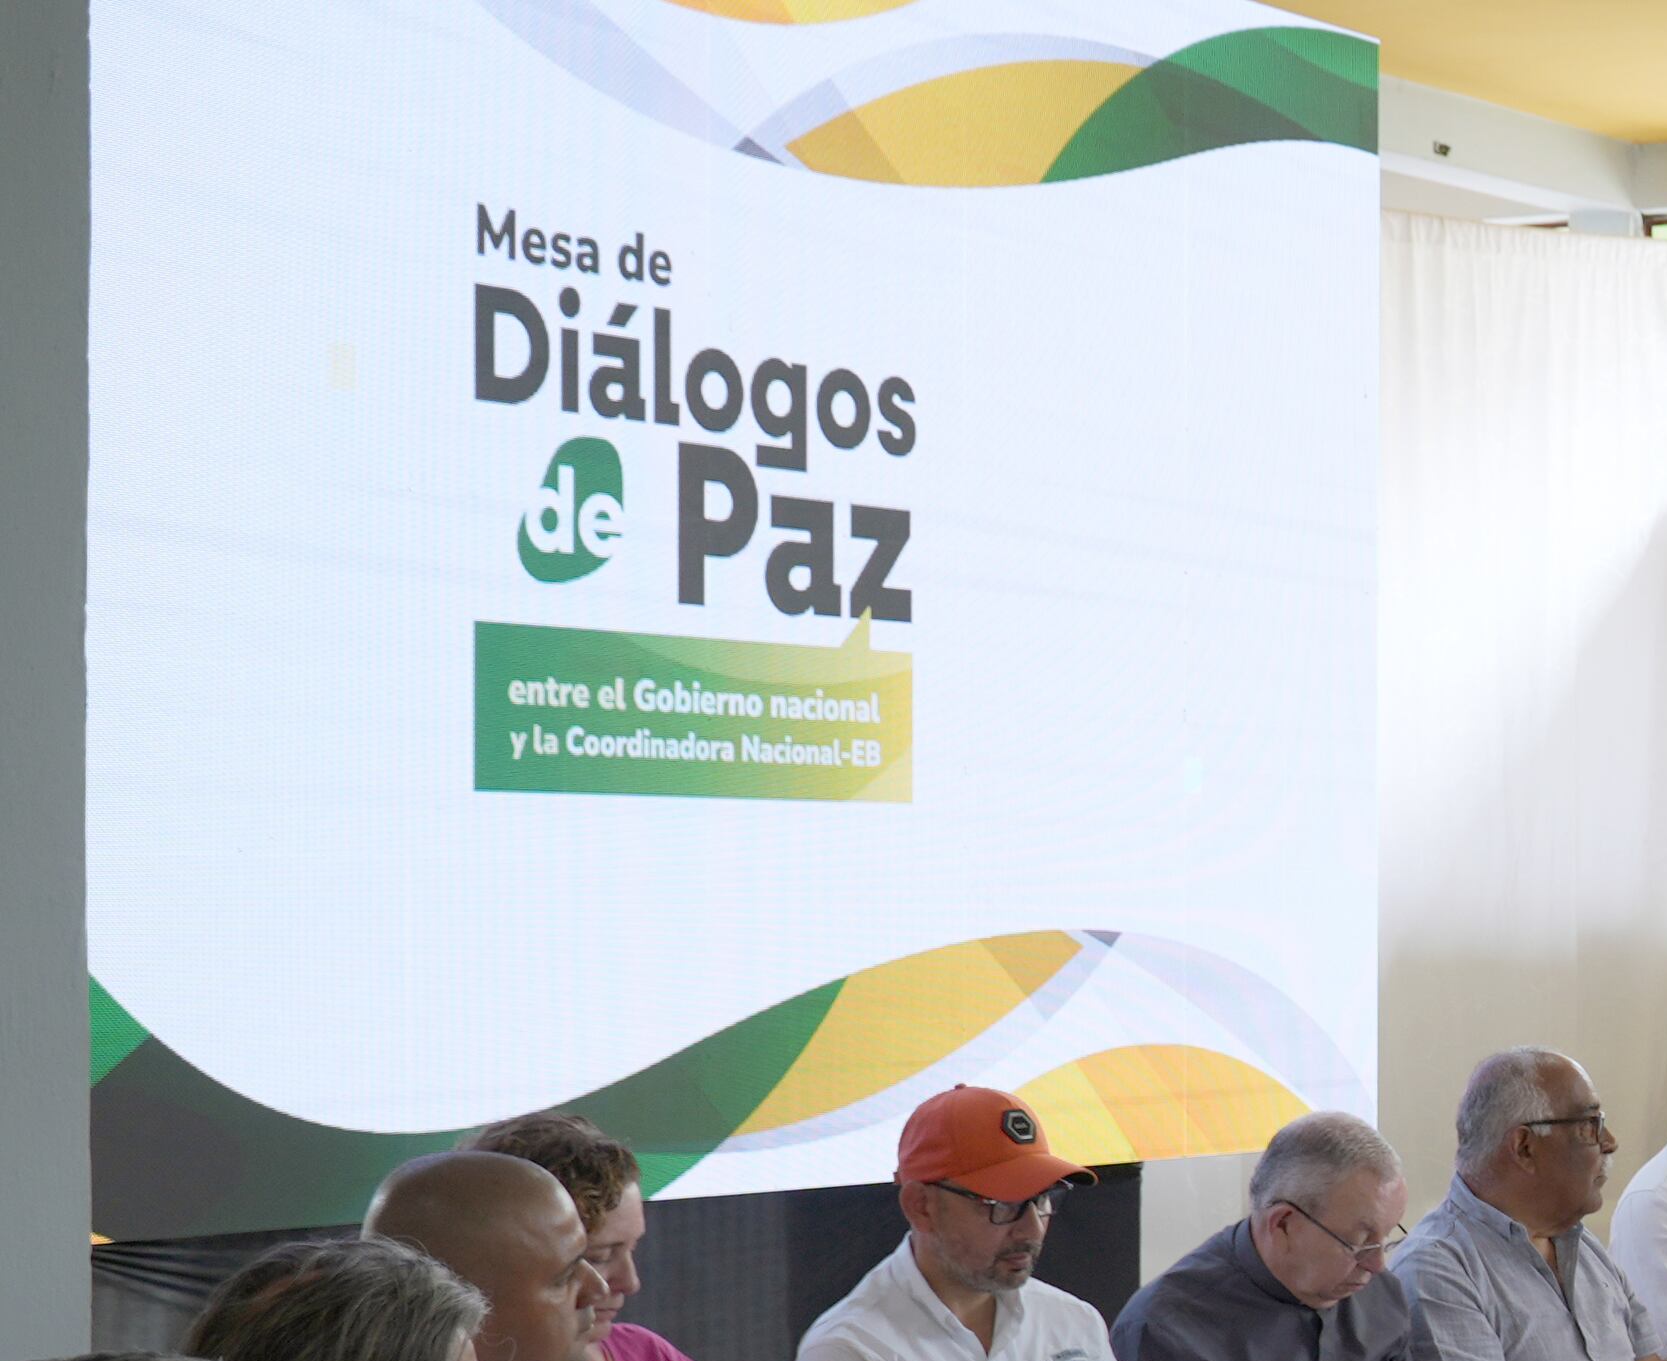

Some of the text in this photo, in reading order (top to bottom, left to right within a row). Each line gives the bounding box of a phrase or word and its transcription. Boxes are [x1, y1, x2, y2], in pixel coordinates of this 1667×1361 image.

[476, 202, 673, 286] Mesa de
[474, 283, 917, 472] Diálogos
[525, 465, 625, 558] de
[678, 441, 913, 624] Paz
[507, 676, 881, 724] entre el Gobierno nacional
[509, 724, 881, 768] y la Coordinadora Nacional-EB
